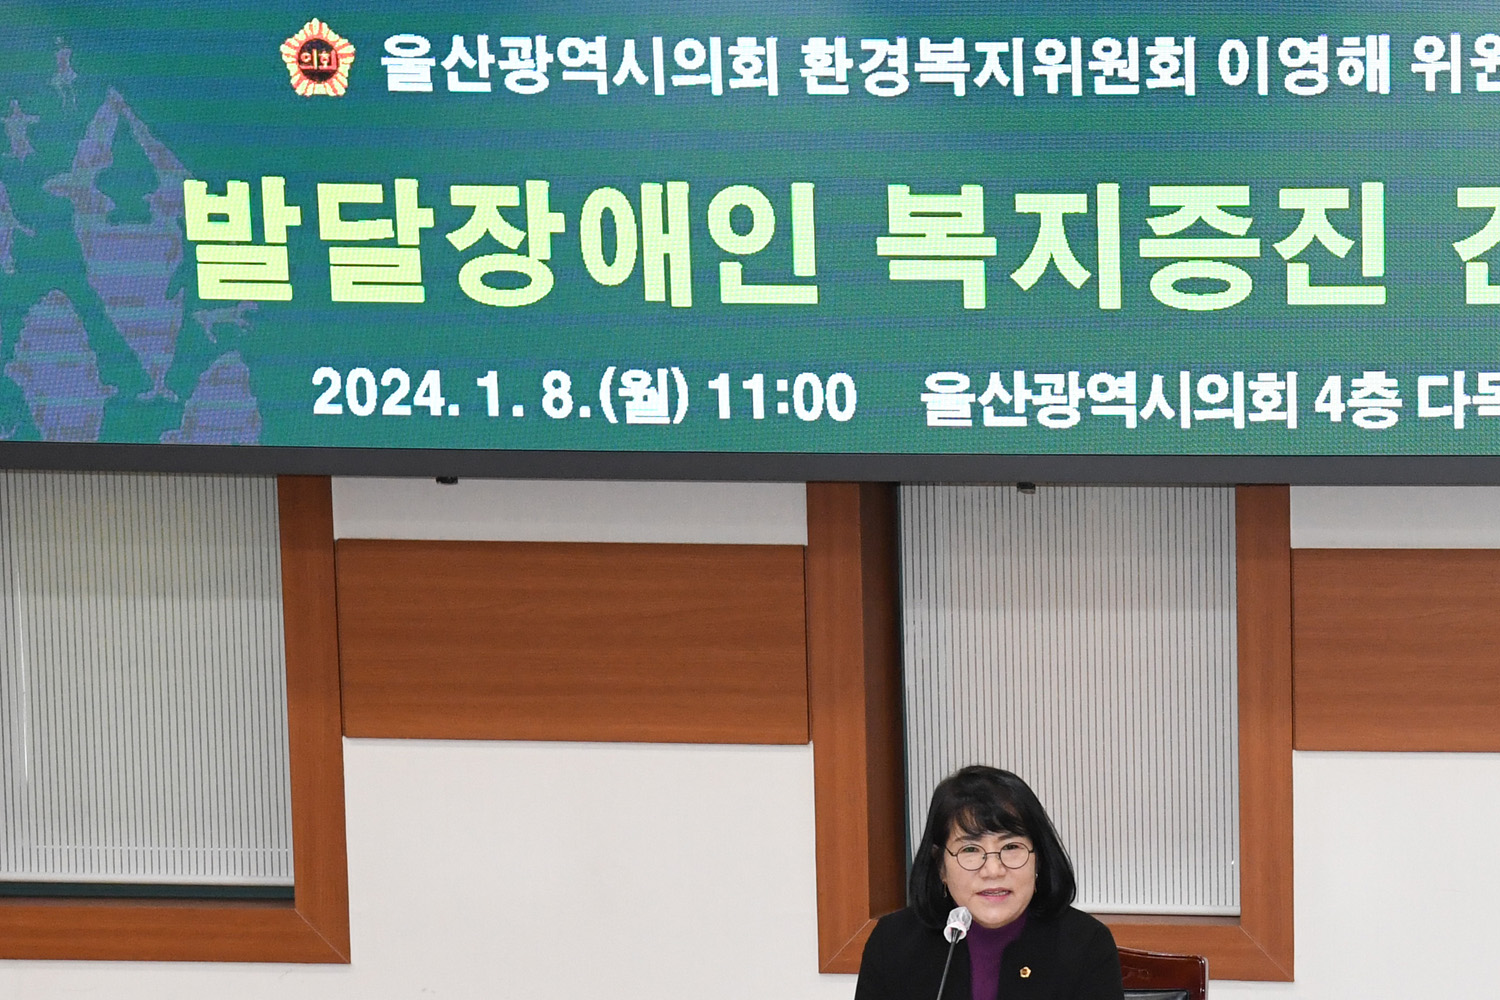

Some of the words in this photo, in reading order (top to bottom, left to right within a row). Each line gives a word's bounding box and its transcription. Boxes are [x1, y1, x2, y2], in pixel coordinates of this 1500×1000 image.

[298, 48, 339, 71] 의회
[383, 35, 780, 96] 울산광역시의회
[800, 37, 1197, 97] 환경복지위원회
[1219, 35, 1390, 96] 이영해
[184, 178, 818, 308] 발달장애인
[877, 183, 1386, 311] 복지증진
[313, 367, 460, 417] 2024.
[478, 371, 525, 417] 1.
[543, 367, 689, 424] 8.(월)
[709, 373, 858, 423] 11:00
[921, 371, 1299, 430] 울산광역시의회
[1315, 371, 1404, 430] 4층
